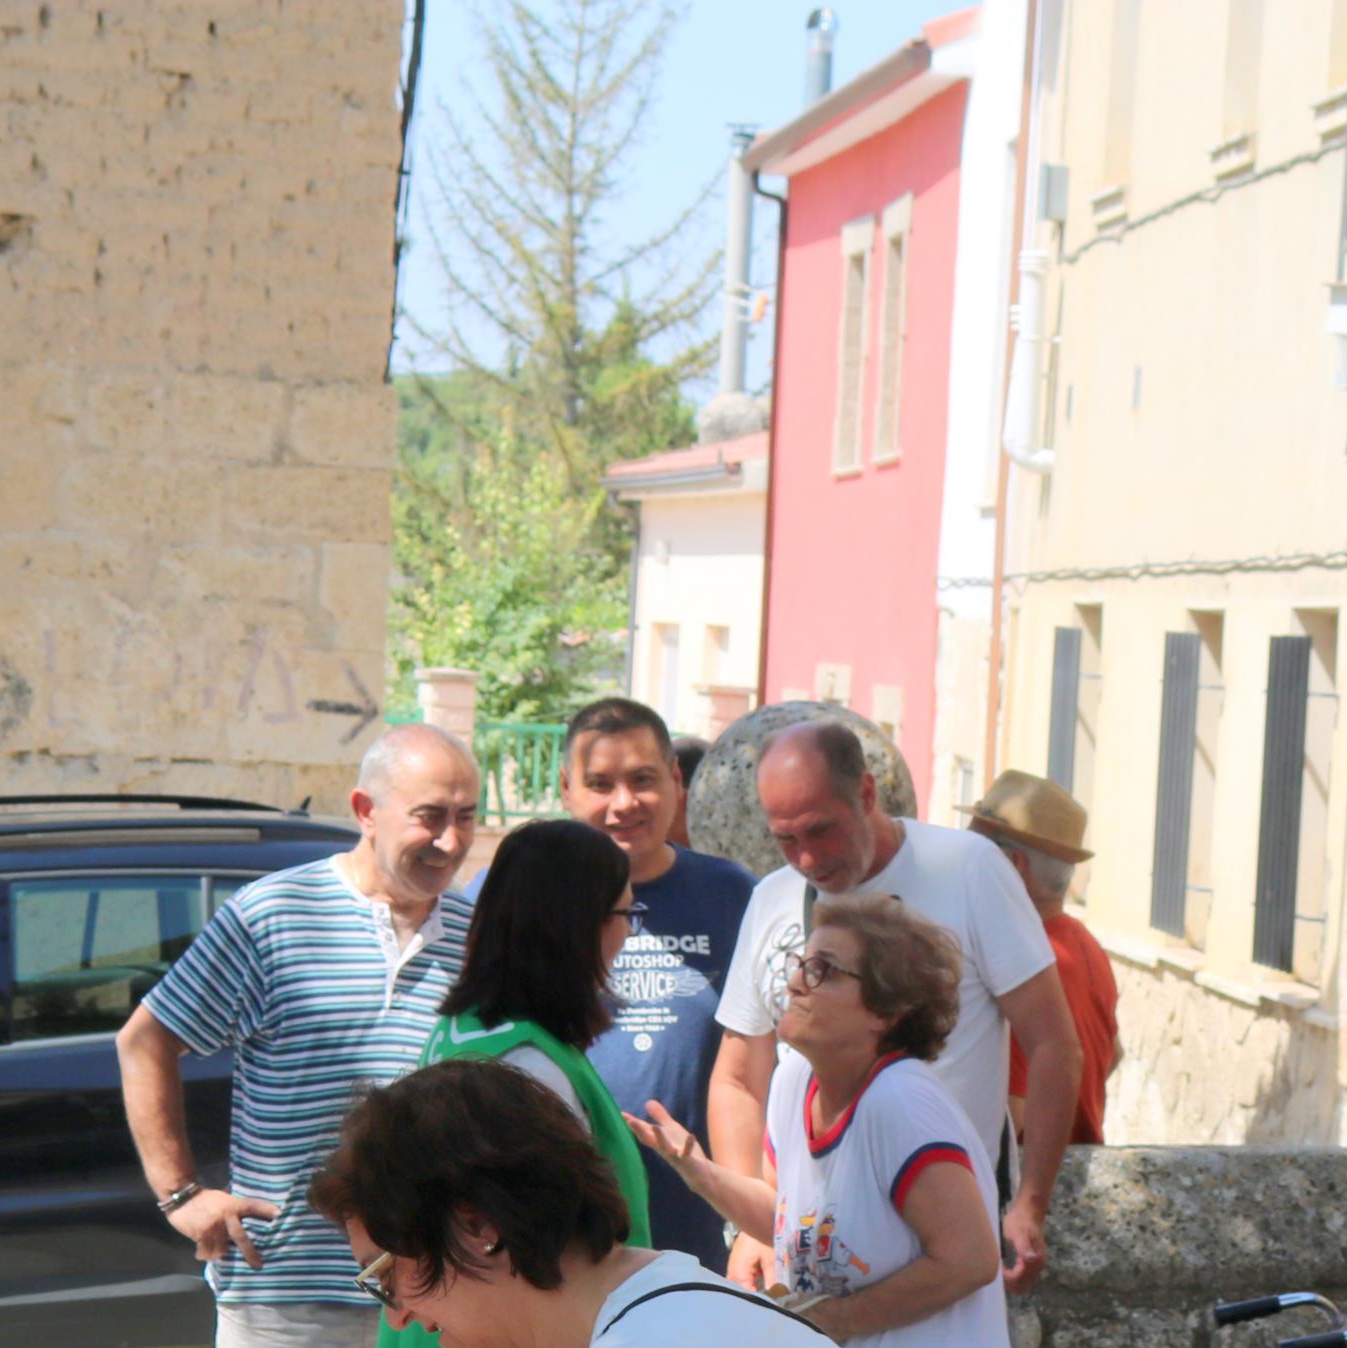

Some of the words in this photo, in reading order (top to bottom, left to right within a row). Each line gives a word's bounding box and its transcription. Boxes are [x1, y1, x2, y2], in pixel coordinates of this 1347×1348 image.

[623, 934, 711, 955] BRIDGE
[613, 953, 684, 969] UTOSHOP
[610, 971, 676, 1000] SERVICE
